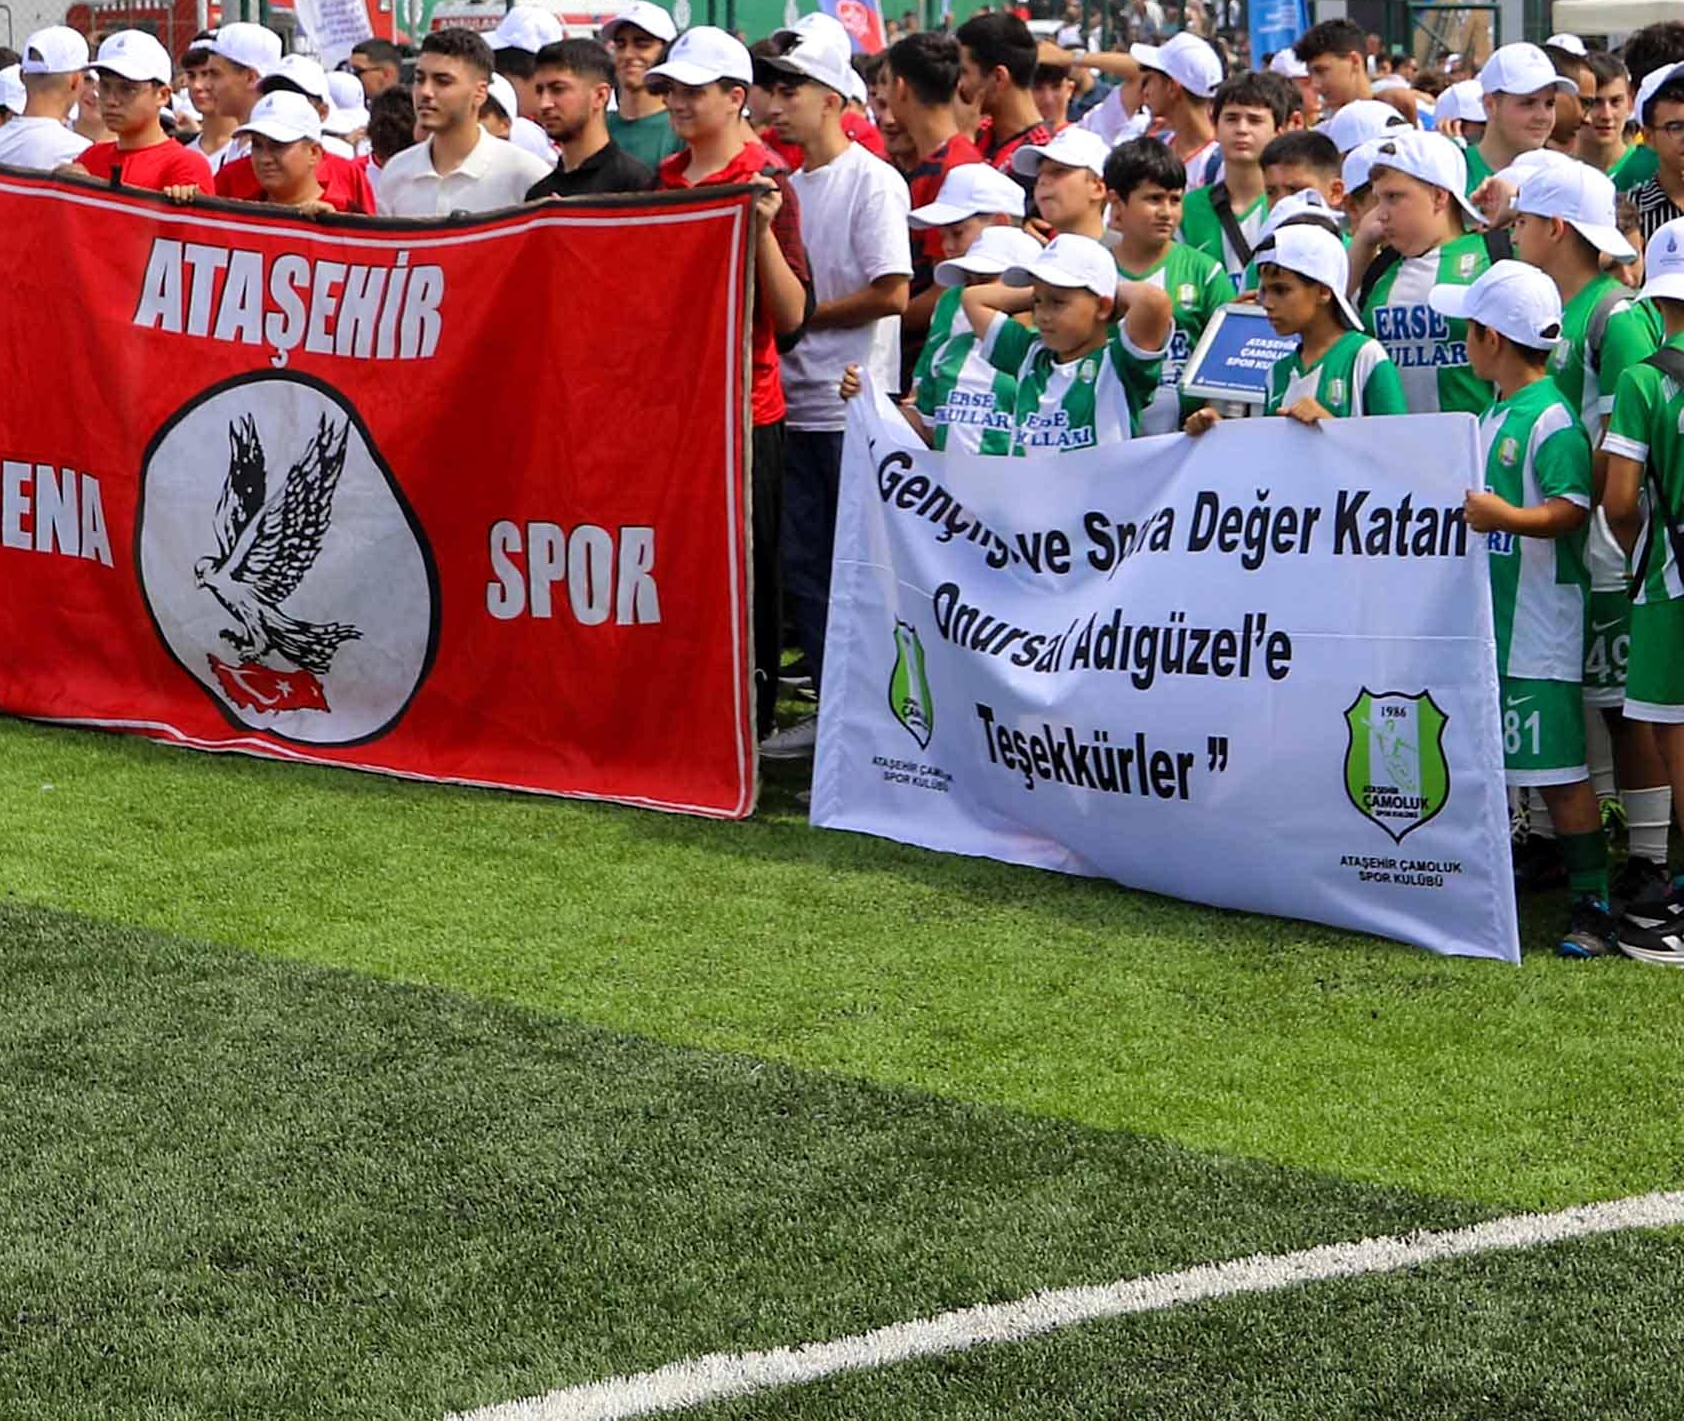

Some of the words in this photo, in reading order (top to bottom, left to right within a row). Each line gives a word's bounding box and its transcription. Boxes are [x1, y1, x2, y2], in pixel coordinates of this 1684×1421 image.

[132, 236, 445, 370] ATAŞEHİR
[1187, 488, 1321, 571] Değer
[1332, 490, 1468, 557] Katan
[485, 521, 661, 627] SPOR
[1381, 706, 1407, 718] 1986
[1503, 710, 1541, 756] 81
[975, 701, 1194, 800] Teşekkürler
[1363, 794, 1430, 811] ÇAMOLUK
[1340, 855, 1397, 870] ATAŞEHİR
[1400, 859, 1462, 874] ÇAMOLUK
[1359, 870, 1392, 883] SPOR
[1393, 873, 1444, 887] KULÜBÜ
